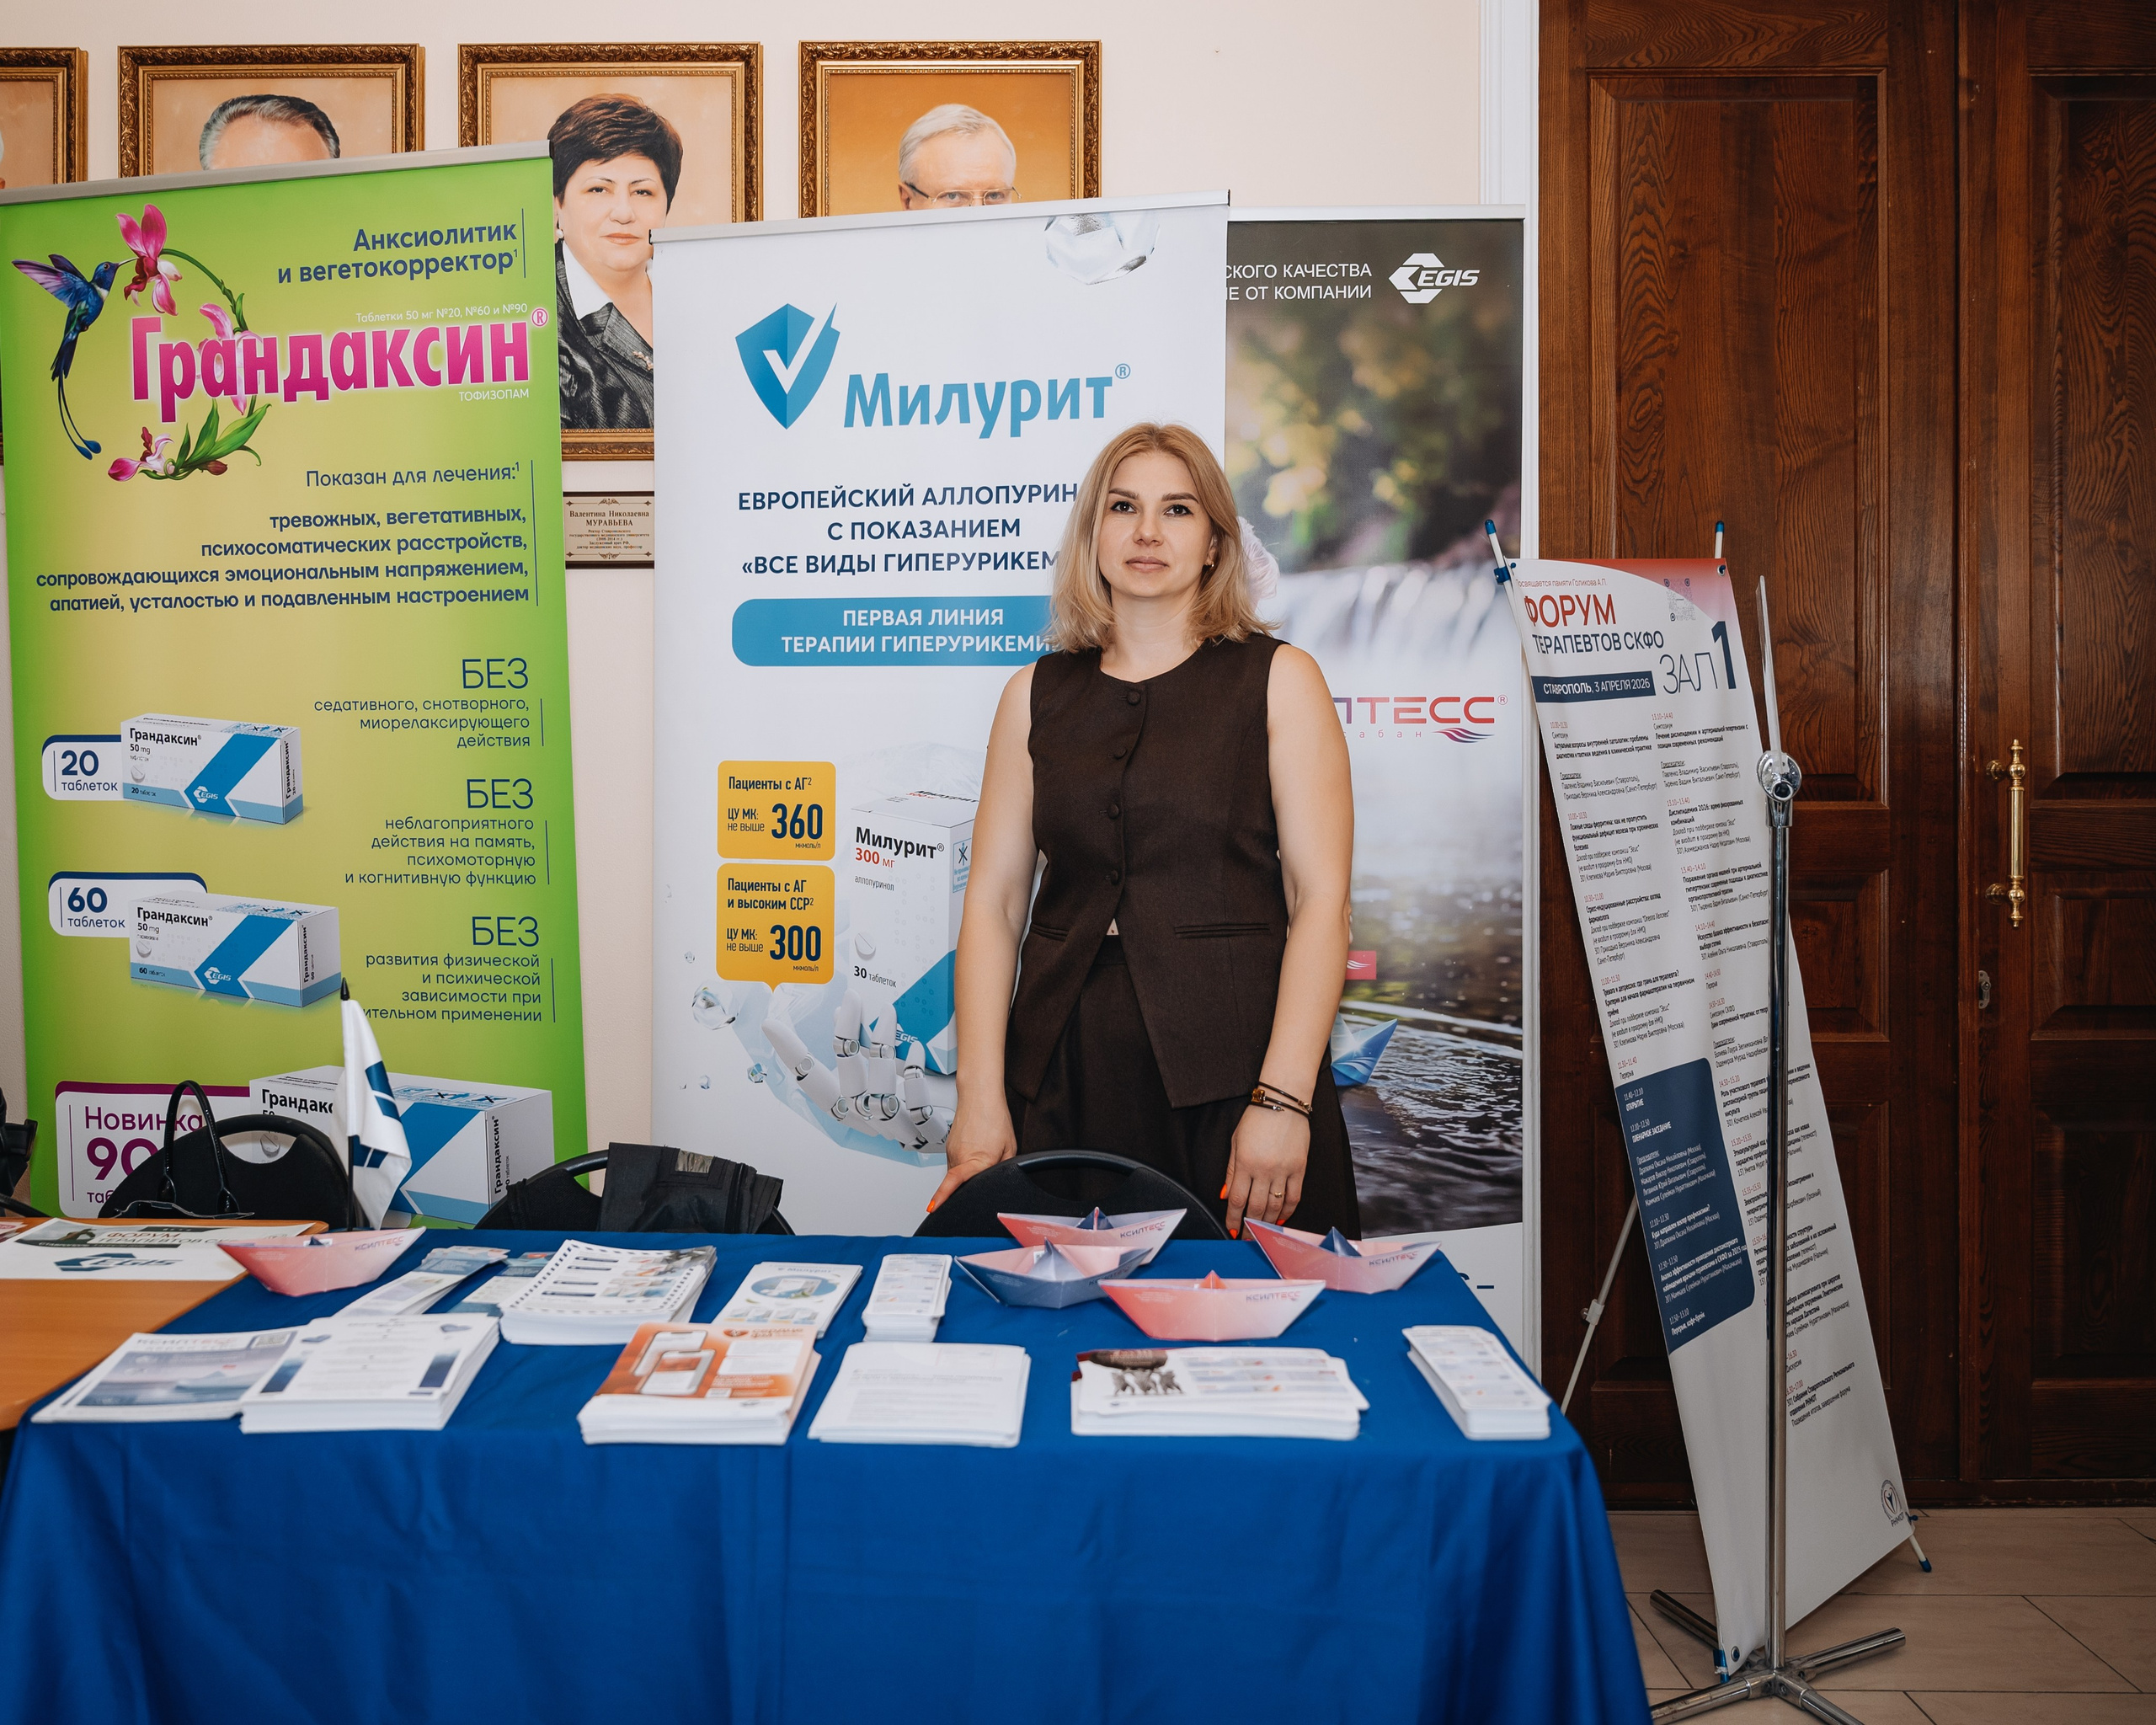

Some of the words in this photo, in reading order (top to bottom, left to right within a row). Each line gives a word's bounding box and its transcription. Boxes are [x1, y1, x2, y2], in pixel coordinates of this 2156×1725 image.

[353, 223, 517, 251] Анксиолитик
[278, 268, 291, 283] и
[1226, 264, 1278, 279] СКОГО
[1283, 263, 1372, 278] КАЧЕСТВА
[1417, 270, 1480, 287] EGIS
[1246, 286, 1268, 300] ОТ
[1274, 285, 1372, 299] КОМПАНИИ
[356, 312, 403, 323] Таблетки
[406, 311, 419, 320] 50
[422, 311, 434, 320] мг
[436, 307, 462, 319] №20,
[465, 306, 490, 316] №60
[503, 303, 527, 313] №90
[458, 388, 529, 401] ТОФИЗОПАМ
[306, 470, 387, 487] Показан
[392, 471, 426, 486] для
[739, 483, 915, 510] ЕВРОПЕЙСКИЙ
[922, 483, 1078, 506] АЛЛОПУРИН
[270, 512, 381, 532] тревожных,
[387, 507, 526, 525] вегетативных,
[827, 521, 843, 540] С
[851, 518, 1021, 540] ПОКАЗАНИЕМ
[201, 538, 391, 557] психосоматических
[398, 532, 527, 554] расстройств,
[742, 555, 798, 574] «ВСЕ
[806, 554, 875, 575] ВИДЫ
[883, 551, 1060, 573] ГИПЕРУРИКЕМ
[36, 569, 219, 589] сопровождающихся
[225, 563, 379, 582] эмоциональным
[385, 561, 528, 580] напряжением,
[50, 594, 125, 611] апатией,
[130, 594, 238, 613] усталостью
[245, 595, 255, 606] и
[261, 591, 390, 608] подавленным
[397, 588, 529, 606] настроением
[843, 608, 922, 626] ПЕРВАЯ
[928, 608, 1004, 625] ЛИНИЯ
[1524, 594, 1616, 628] ФОРУМ
[782, 635, 875, 653] ТЕРАПИИ
[881, 635, 1056, 653] ГИПЕРУРИКЕМИ
[1532, 633, 1622, 654] ТЕРАПЕВТОВ
[1624, 630, 1664, 649] СКФО
[1659, 652, 1719, 694] ЗАЛ
[1710, 621, 1737, 689] 1
[462, 657, 529, 689] БЕЗ
[1543, 682, 1594, 695] СТАВРОПОЛЬ,
[1594, 682, 1600, 692] 3
[1601, 680, 1631, 692] АПРЕЛЯ
[1632, 678, 1651, 689] 2026
[314, 699, 418, 713] седативного,
[423, 698, 530, 713] снотворного,
[360, 717, 530, 732] миорелаксирующего
[456, 734, 531, 749] действия
[1343, 729, 1422, 739] абан
[130, 743, 140, 752] 50
[141, 745, 151, 755] mg
[61, 750, 99, 777] 20
[61, 779, 118, 792] таблеток
[728, 777, 782, 790] Пациенты
[785, 781, 791, 790] с
[467, 778, 534, 809] БЕЗ
[728, 809, 739, 821] ЦУ
[742, 809, 759, 820] МК:
[771, 803, 823, 840] 360
[385, 817, 534, 833] неблагоприятного
[727, 822, 738, 831] не
[740, 822, 765, 831] выше
[371, 836, 445, 849] действия
[450, 837, 470, 847] на
[475, 837, 536, 850] память,
[407, 855, 536, 869] психомоторную
[855, 847, 879, 865] 300
[882, 857, 895, 868] мг
[345, 873, 354, 884] и
[359, 873, 461, 886] когнитивную
[466, 871, 536, 887] функцию
[728, 878, 781, 893] Пациенты
[784, 884, 790, 892] с
[793, 880, 807, 893] АГ
[854, 876, 894, 891] аллопуринол
[67, 887, 108, 913] 60
[728, 900, 734, 909] и
[737, 899, 787, 910] высоким
[67, 916, 125, 928] таблеток
[137, 923, 147, 932] 50
[149, 925, 160, 935] mg
[472, 916, 540, 947] БЕЗ
[726, 928, 739, 942] ЦУ
[741, 929, 758, 941] МК:
[726, 943, 736, 952] не
[739, 943, 764, 953] выше
[770, 925, 821, 962] 300
[366, 954, 439, 968] развития
[443, 953, 540, 969] физической
[422, 973, 431, 984] и
[436, 972, 541, 985] психической
[853, 966, 867, 980] 30
[869, 973, 897, 988] таблеток
[402, 991, 507, 1003] зависимости
[512, 992, 542, 1005] при
[363, 1008, 437, 1020] ительном
[441, 1009, 542, 1023] применении
[262, 1089, 334, 1114] Грандак
[85, 1106, 203, 1131] Новинка
[1120, 1222, 1166, 1239] КСИЛТЕСС
[355, 1236, 404, 1252] КСИЛТЕСС
[1369, 1250, 1419, 1266] КСИЛТЕСС
[1246, 1291, 1302, 1302] КСИЛТЕСС
